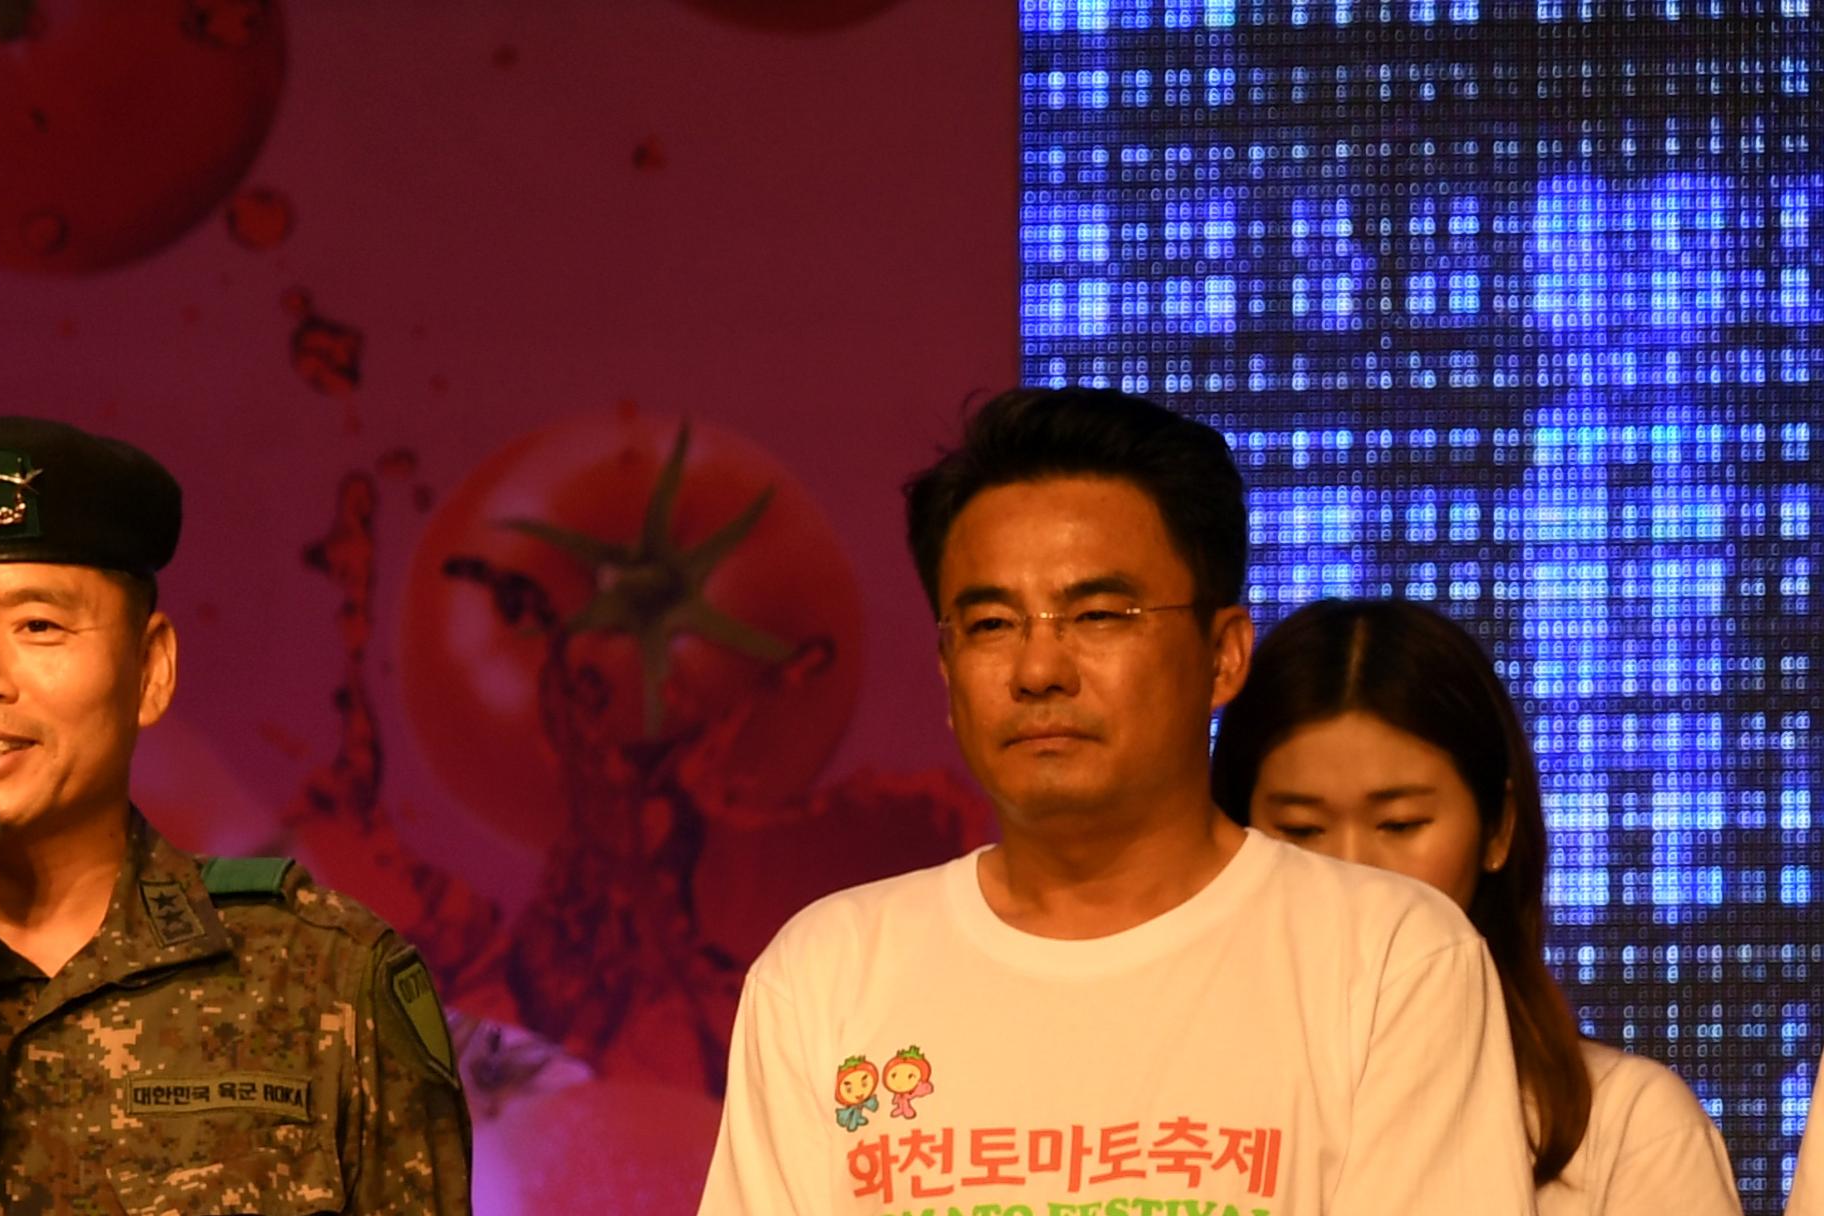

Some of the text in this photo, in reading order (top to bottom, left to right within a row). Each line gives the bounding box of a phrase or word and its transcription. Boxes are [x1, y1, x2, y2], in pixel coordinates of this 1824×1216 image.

[132, 1081, 304, 1107] 대한민국 육군 ROKA
[846, 1116, 1283, 1204] 화천토마토축제
